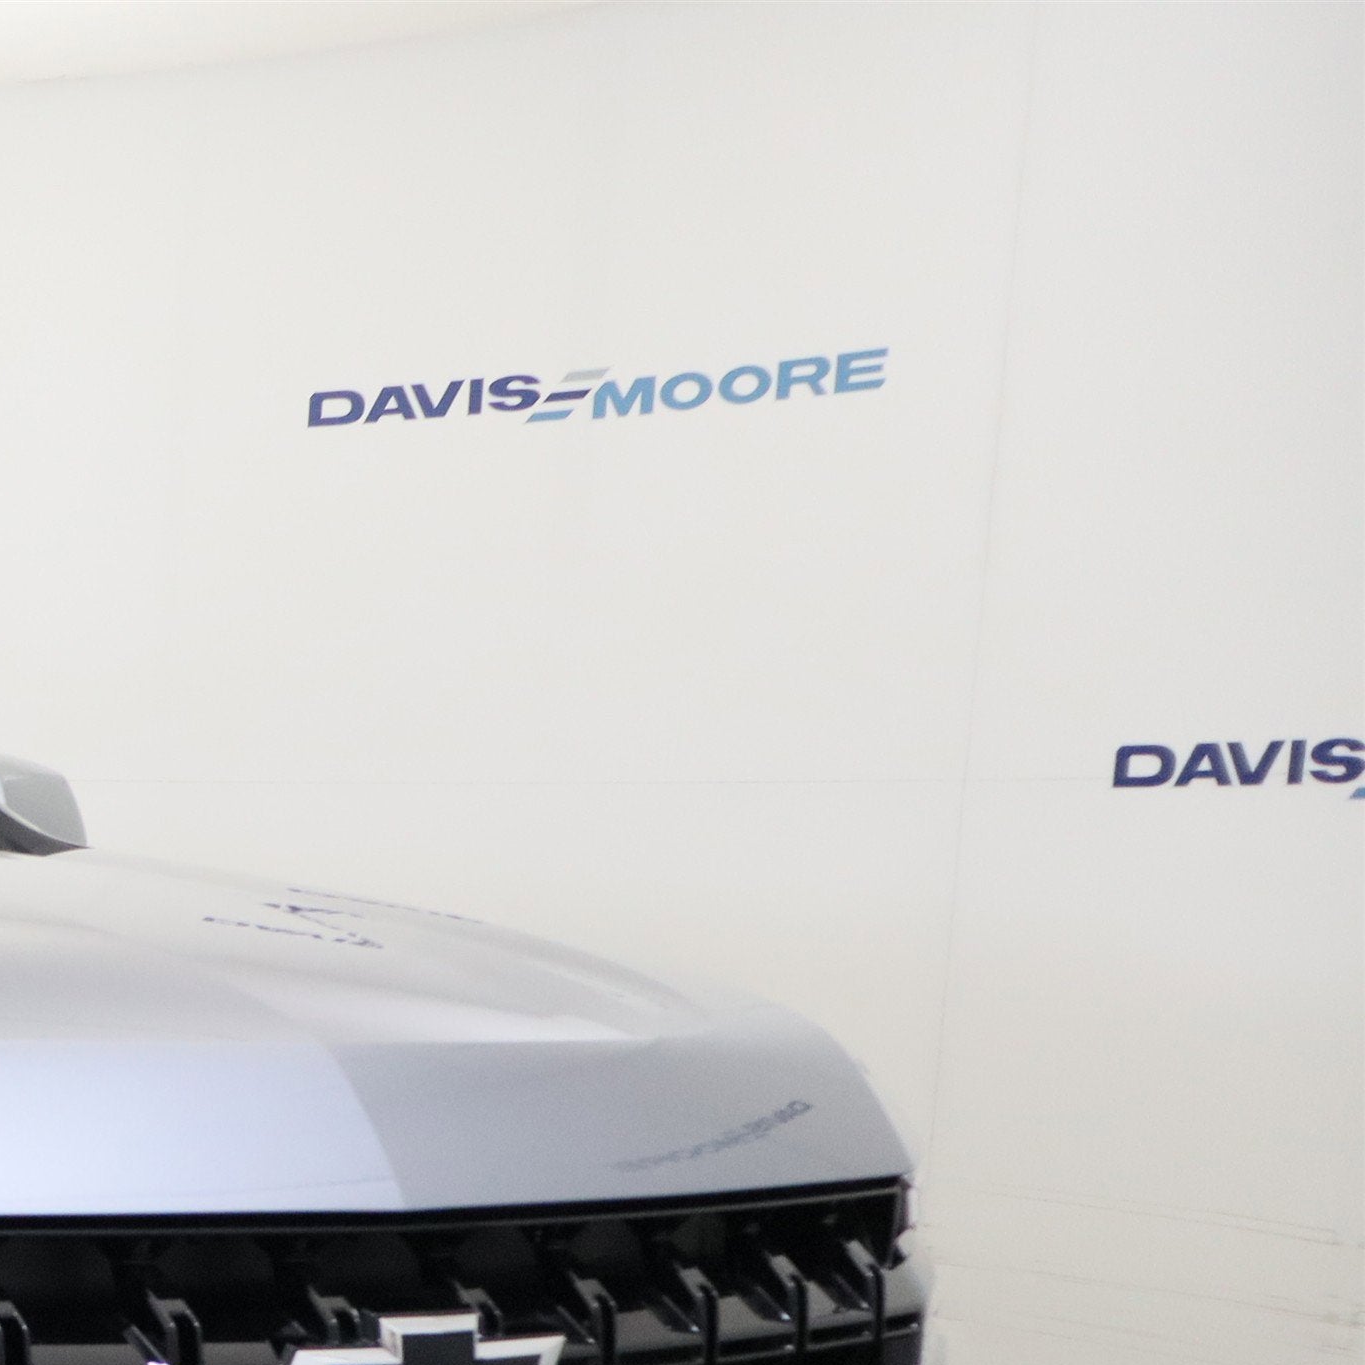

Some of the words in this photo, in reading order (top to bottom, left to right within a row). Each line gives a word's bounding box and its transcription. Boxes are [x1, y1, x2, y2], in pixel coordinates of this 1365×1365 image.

[307, 374, 541, 428] DAVIS
[591, 346, 890, 421] MOORE
[1112, 737, 1365, 788] DAVIS
